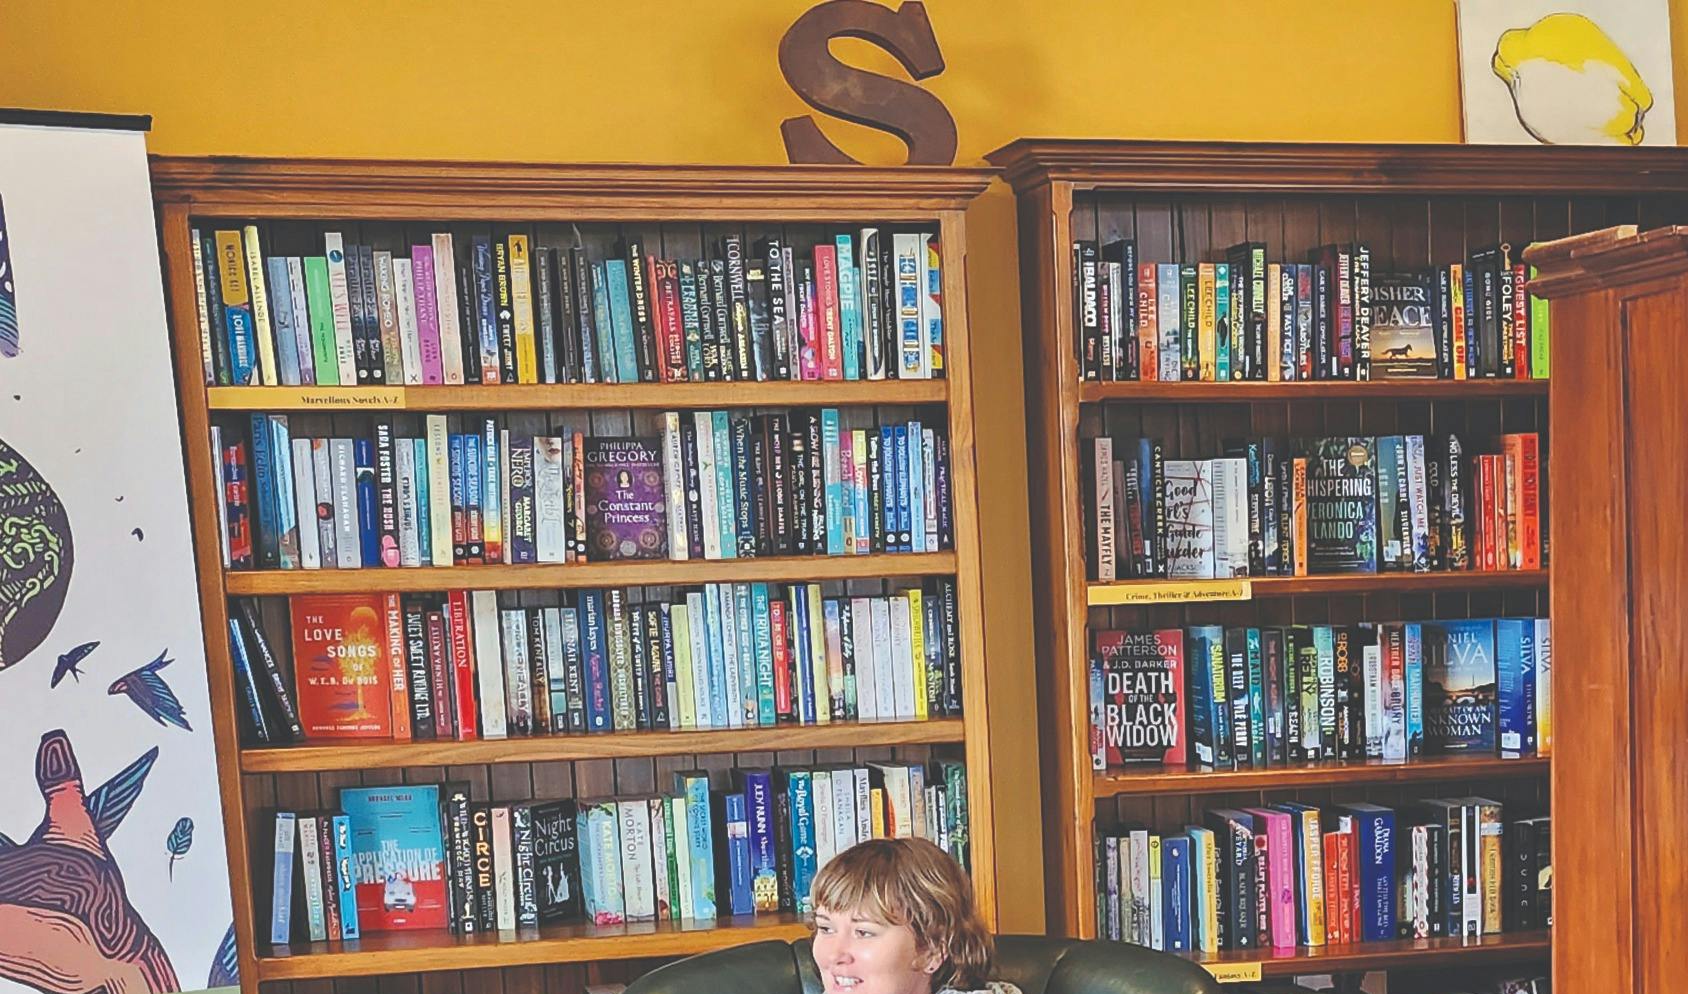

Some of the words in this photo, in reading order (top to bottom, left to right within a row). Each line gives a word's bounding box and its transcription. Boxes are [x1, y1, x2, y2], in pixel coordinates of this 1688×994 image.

[769, 240, 779, 259] TO
[727, 243, 744, 302] CORNWELL
[771, 265, 782, 290] THE
[840, 245, 852, 310] MAGPIE
[1360, 247, 1370, 303] JEFFERY
[1187, 283, 1195, 300] LEE
[1503, 277, 1511, 320] FOLEY
[1516, 276, 1524, 316] GUEST
[773, 297, 784, 324] SEA
[1140, 292, 1148, 327] CHILD
[1361, 308, 1370, 358] DEAVER
[1517, 320, 1525, 346] LIST
[736, 425, 744, 453] When
[512, 448, 523, 487] NERO
[587, 451, 657, 463] GREGORY
[738, 456, 746, 469] the
[1322, 459, 1345, 476] THE
[739, 471, 748, 500] Music
[1414, 466, 1423, 484] JUST
[616, 490, 634, 500] The
[1308, 479, 1371, 497] HISPERING
[598, 500, 655, 511] Constant
[1416, 488, 1424, 514] WATCH
[605, 513, 650, 523] Princess
[740, 502, 749, 527] Stops
[1100, 505, 1110, 524] THE
[1314, 522, 1354, 539] LANDO
[1101, 527, 1111, 565] MAYFLY
[587, 595, 597, 626] marian
[756, 595, 765, 611] THE
[306, 616, 324, 624] THE
[757, 613, 768, 647] TRIVIA
[304, 629, 343, 641] LOVE
[388, 610, 401, 655] MAKING
[452, 602, 466, 668] LIBERATION
[587, 626, 599, 650] keyes
[1117, 634, 1160, 644] JAMES
[327, 645, 376, 658] SONGS
[1101, 645, 1177, 656] PATTERSON
[1337, 642, 1348, 672] ROBB
[1521, 637, 1531, 674] SILVA
[759, 648, 771, 687] NIGHT
[1135, 660, 1177, 669] BARKER
[1211, 645, 1226, 703] SANATORIUM
[392, 669, 405, 690] HER
[569, 665, 579, 694] KENT
[1108, 672, 1173, 694] DEATH
[1320, 658, 1335, 726] ROBINSON
[1106, 704, 1177, 725] BLACK
[1106, 725, 1177, 747] WIDOW
[535, 817, 572, 837] Night
[624, 808, 635, 861] MORTON
[353, 849, 421, 865] APPLICATION
[424, 848, 437, 863] OF
[381, 840, 398, 850] THE
[474, 812, 491, 887] CIRCE
[535, 836, 575, 855] Circus
[354, 860, 441, 883] PRESSURE
